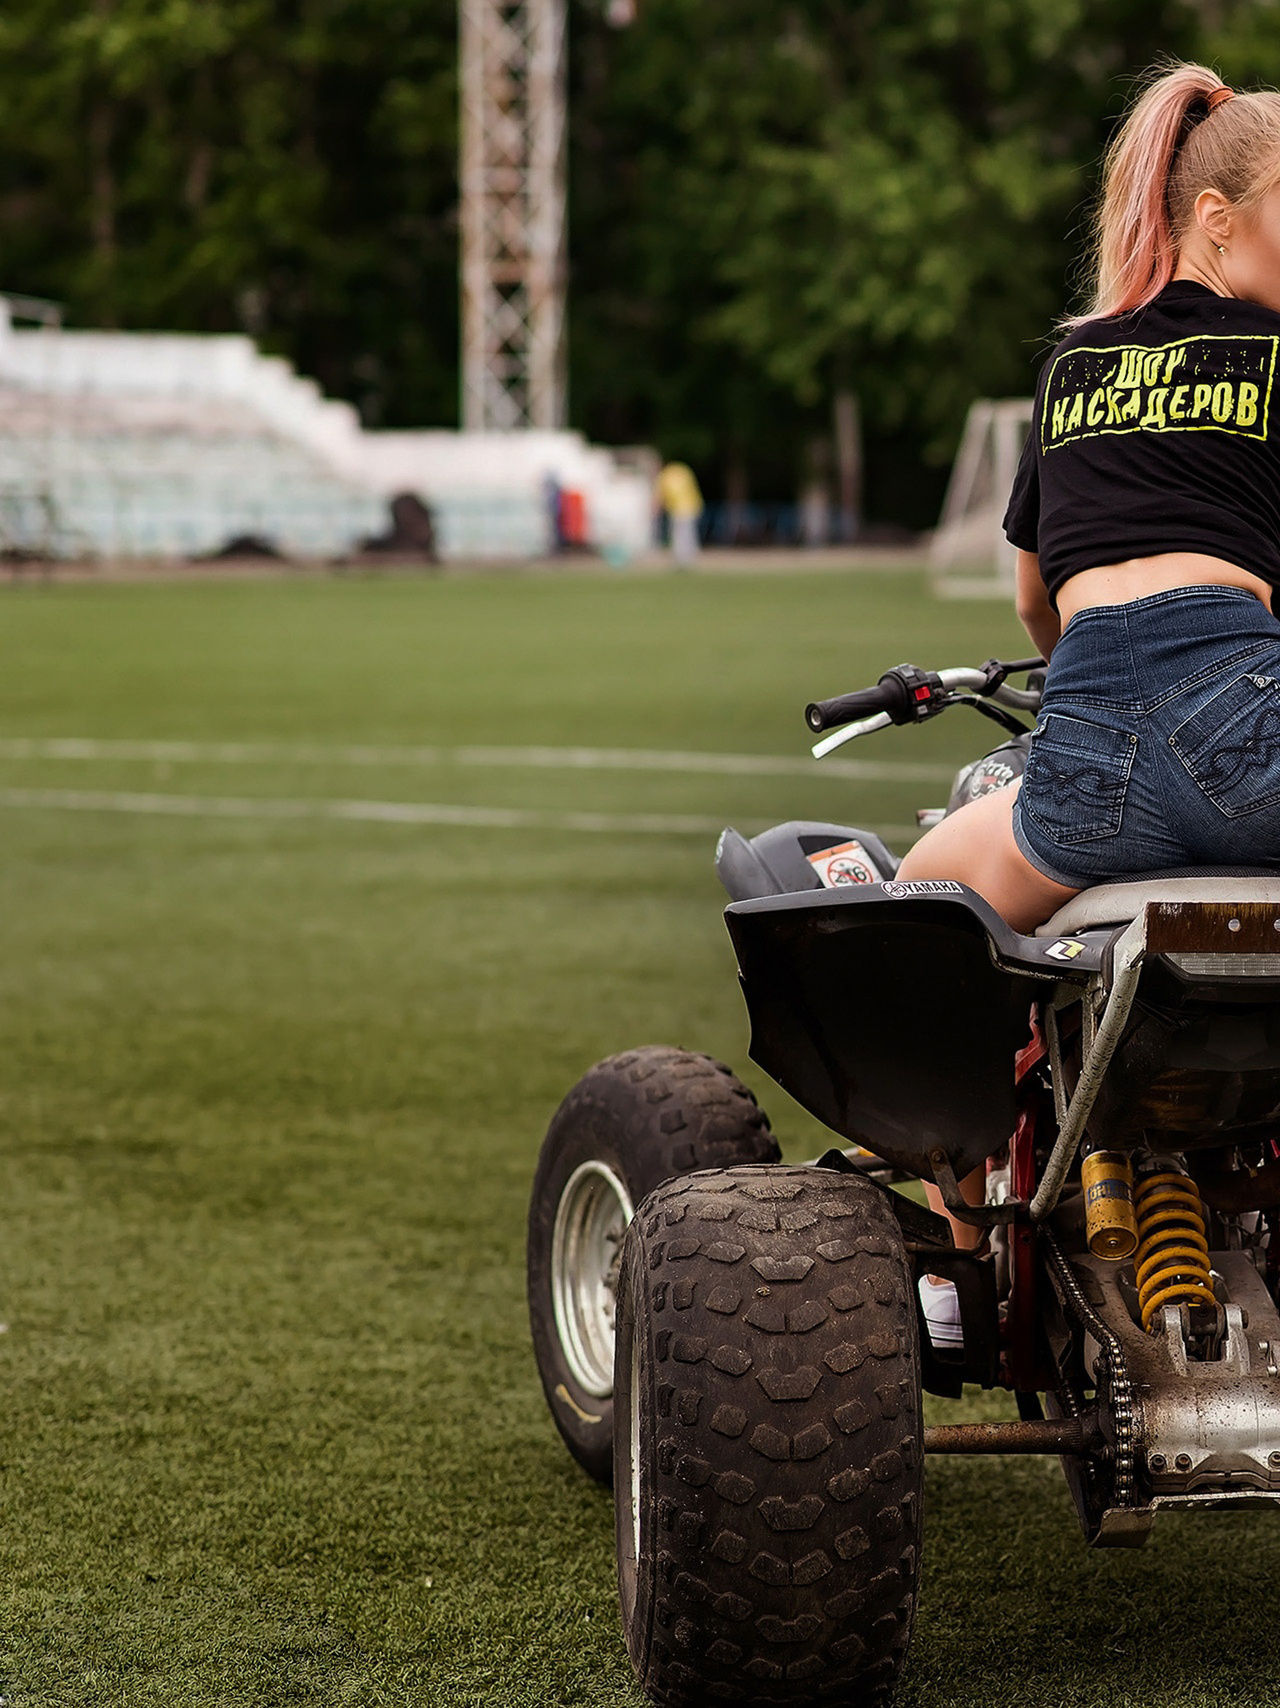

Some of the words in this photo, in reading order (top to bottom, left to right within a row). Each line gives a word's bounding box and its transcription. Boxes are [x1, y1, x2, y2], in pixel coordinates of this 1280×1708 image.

[1115, 347, 1186, 389] ШОУ
[1051, 381, 1259, 439] КАСКАДЕРОВ
[905, 882, 961, 893] YAMAHA
